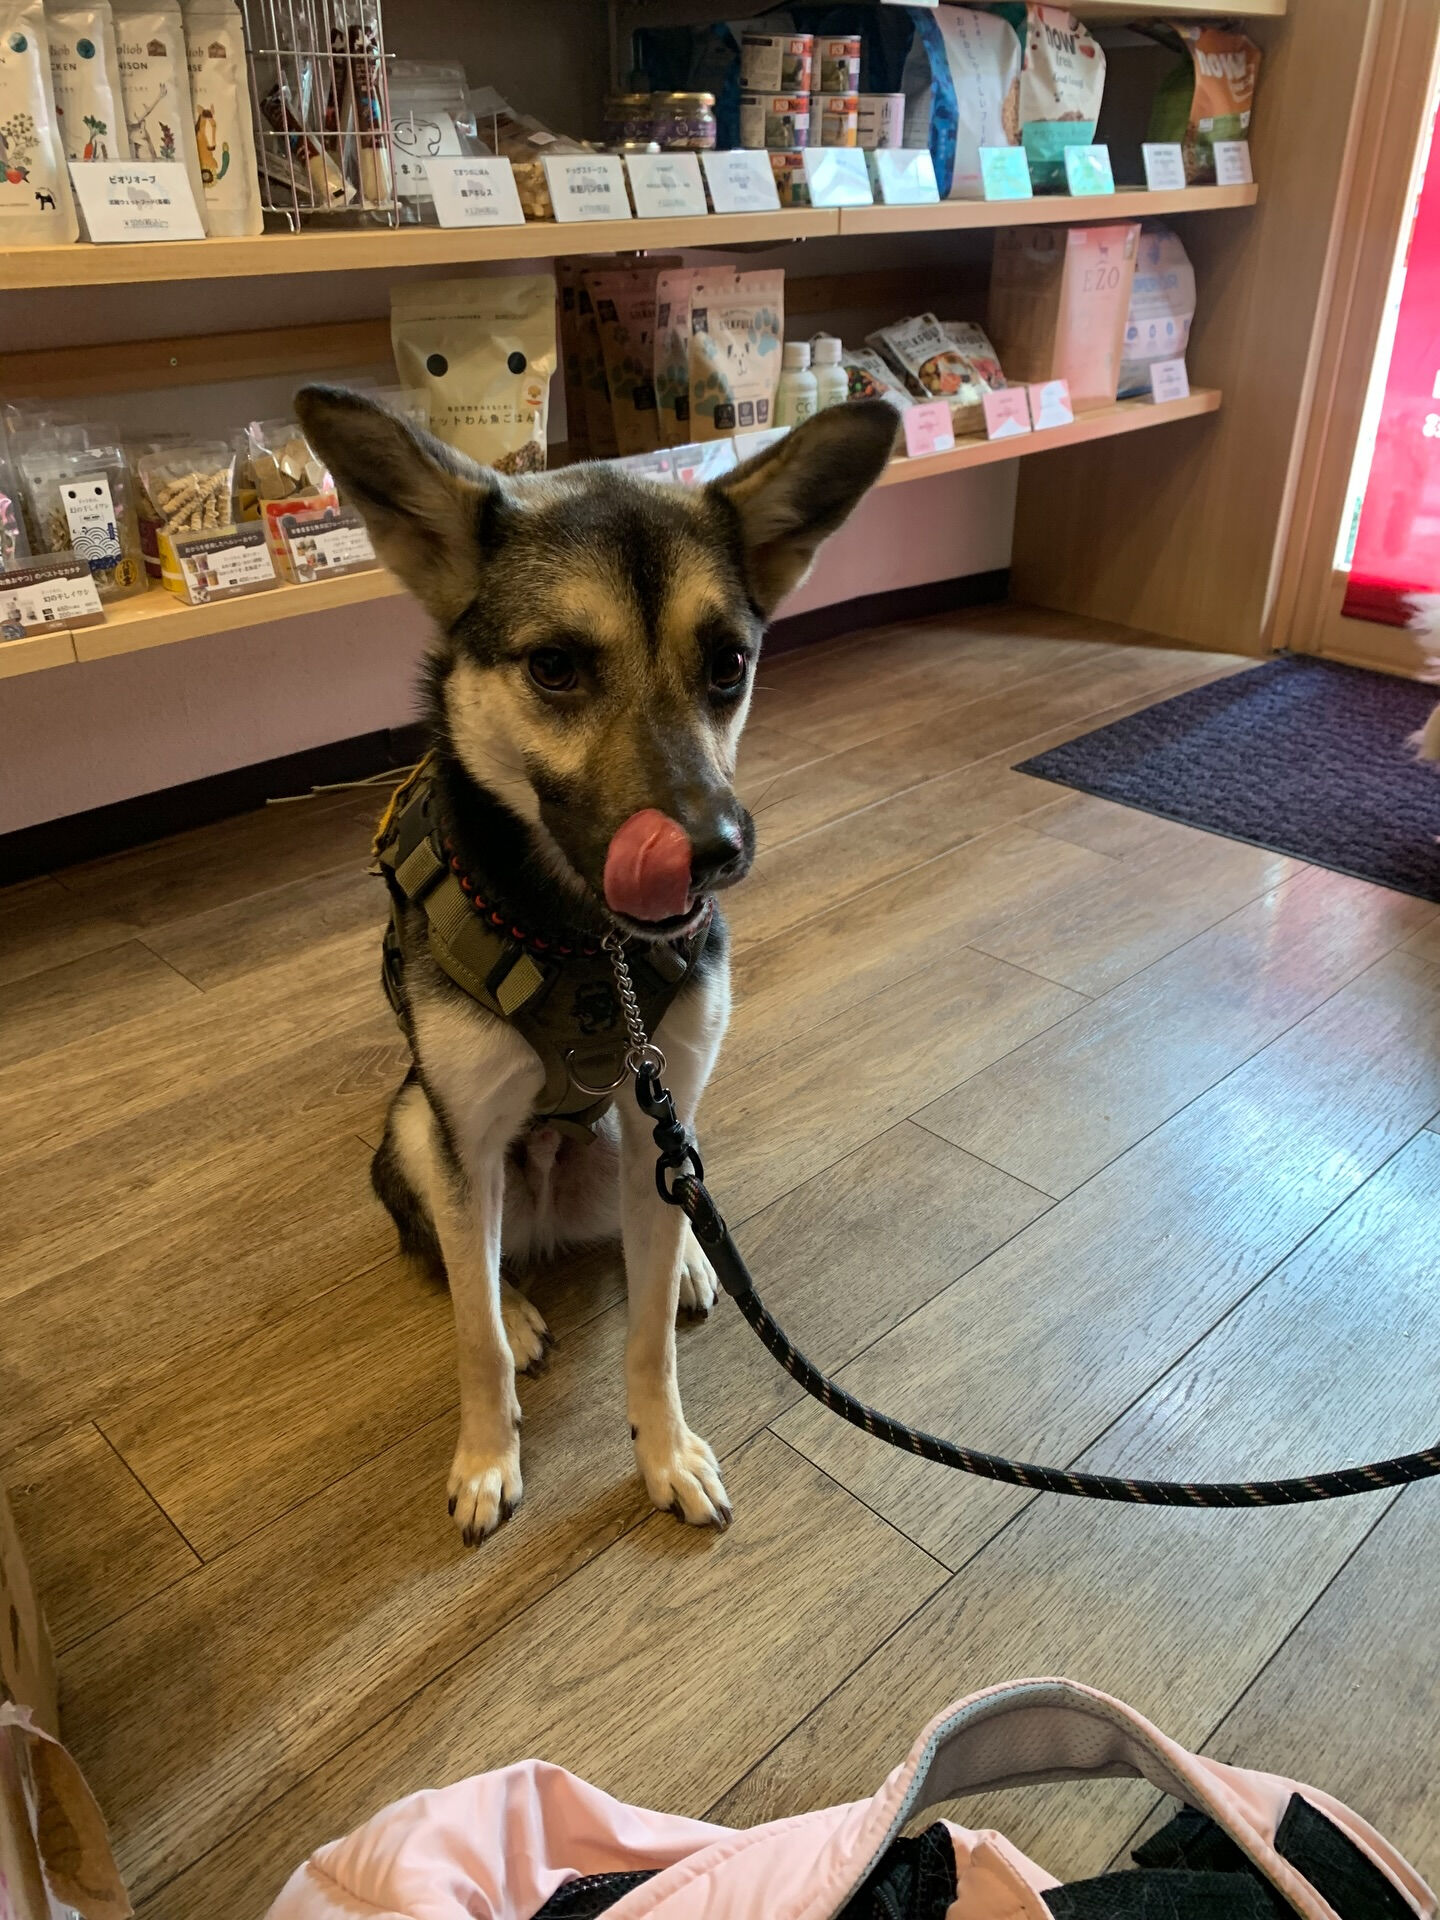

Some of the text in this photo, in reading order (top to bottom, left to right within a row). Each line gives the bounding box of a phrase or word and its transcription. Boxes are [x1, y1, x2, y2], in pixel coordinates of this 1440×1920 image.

[429, 413, 535, 426] ドットわん魚ごはん
